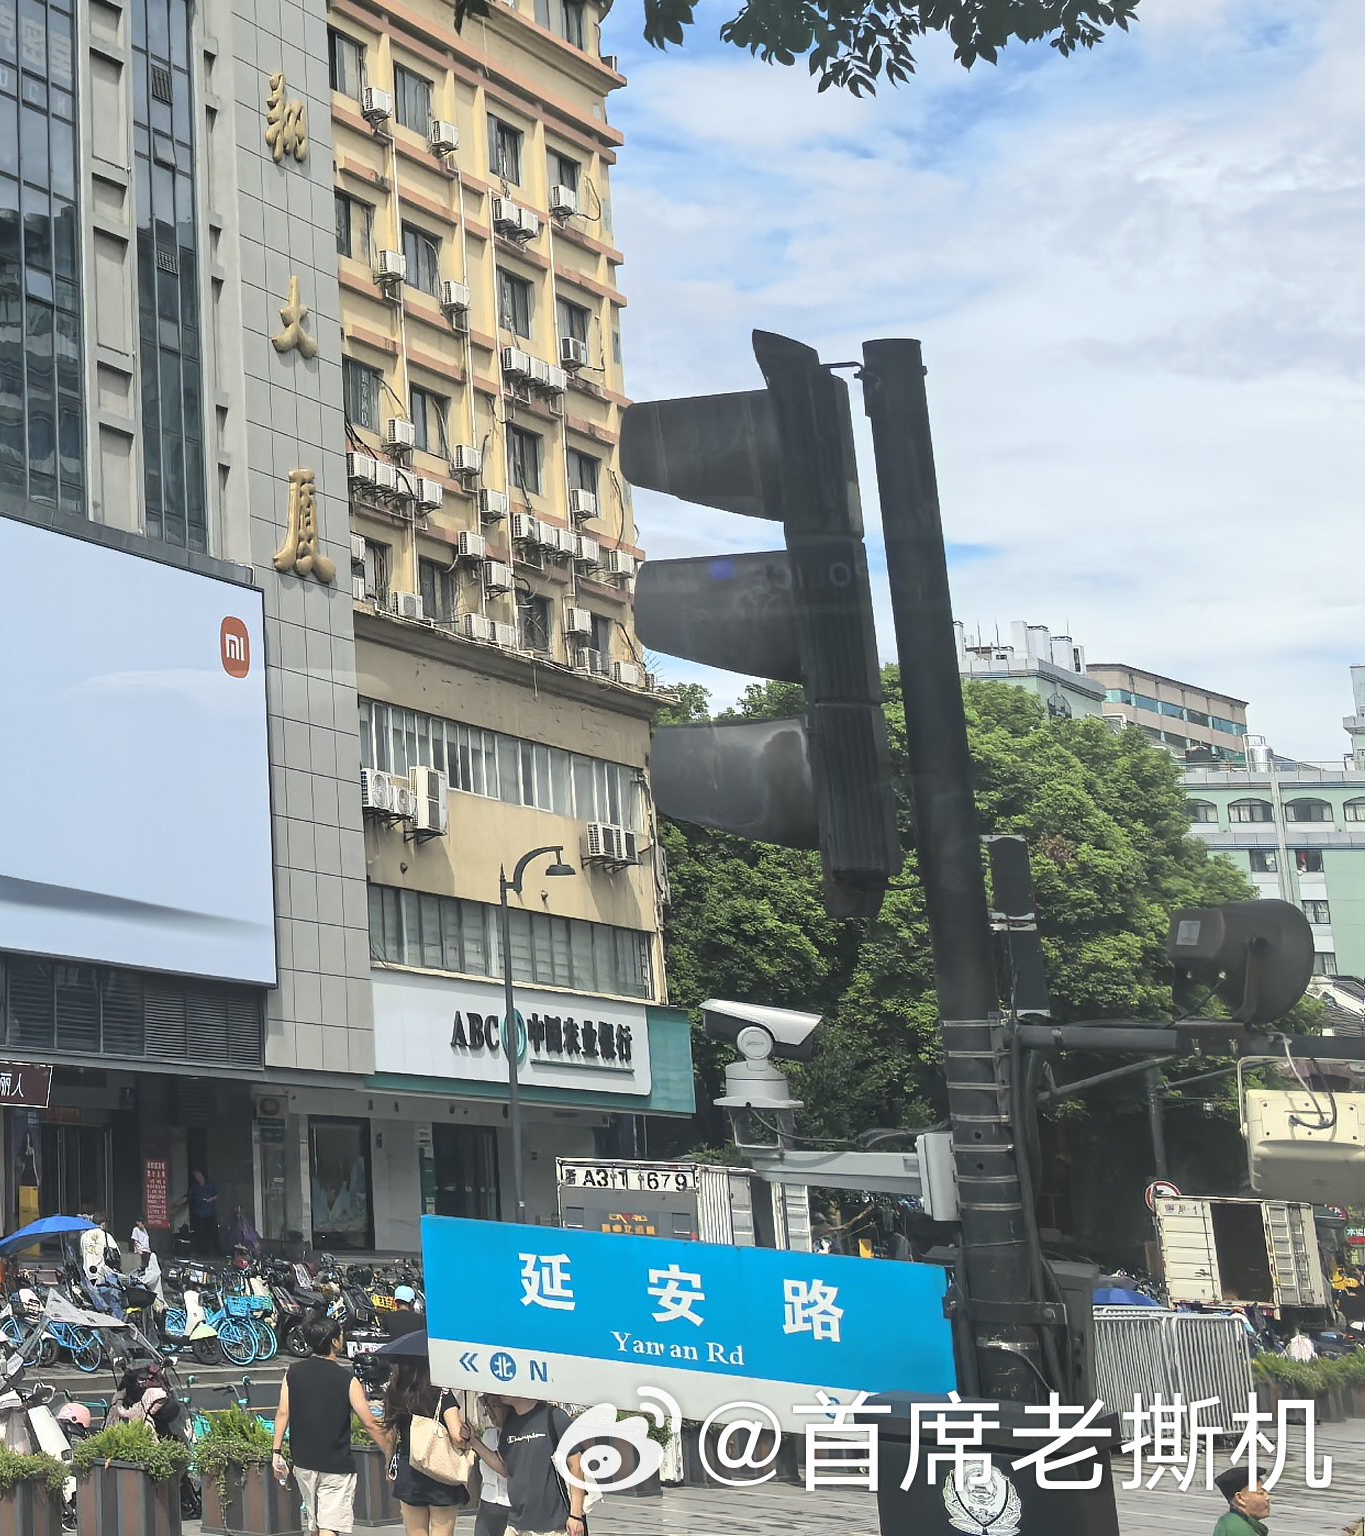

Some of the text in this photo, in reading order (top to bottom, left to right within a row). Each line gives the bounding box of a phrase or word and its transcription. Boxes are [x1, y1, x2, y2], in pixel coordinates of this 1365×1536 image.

[450, 1010, 500, 1051] ABC
[517, 1251, 845, 1343] 延安路
[706, 1341, 745, 1366] Rd
[529, 1359, 548, 1382] N
